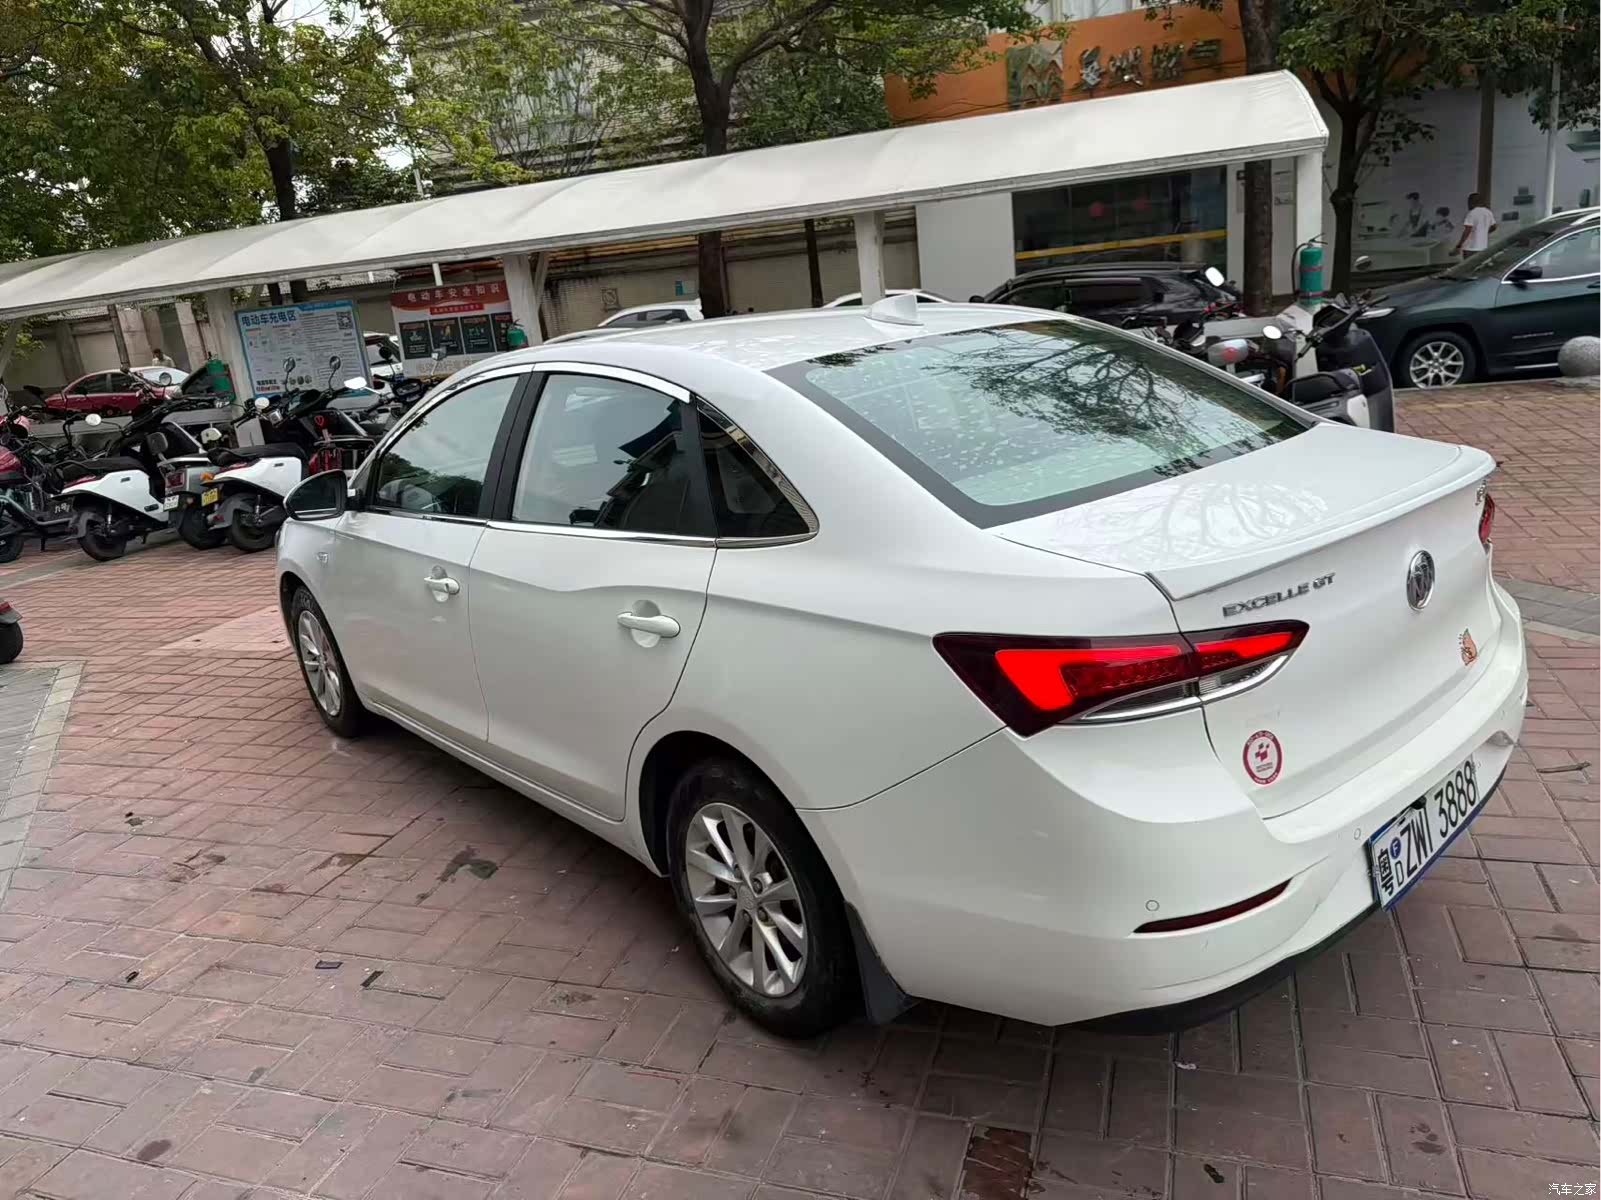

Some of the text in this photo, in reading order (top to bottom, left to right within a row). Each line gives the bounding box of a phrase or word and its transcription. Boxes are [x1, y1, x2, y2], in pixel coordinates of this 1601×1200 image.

[407, 283, 500, 302] 电动车安全知识
[241, 310, 297, 327] 电动车充电区
[1222, 572, 1336, 617] EXCELLE GT
